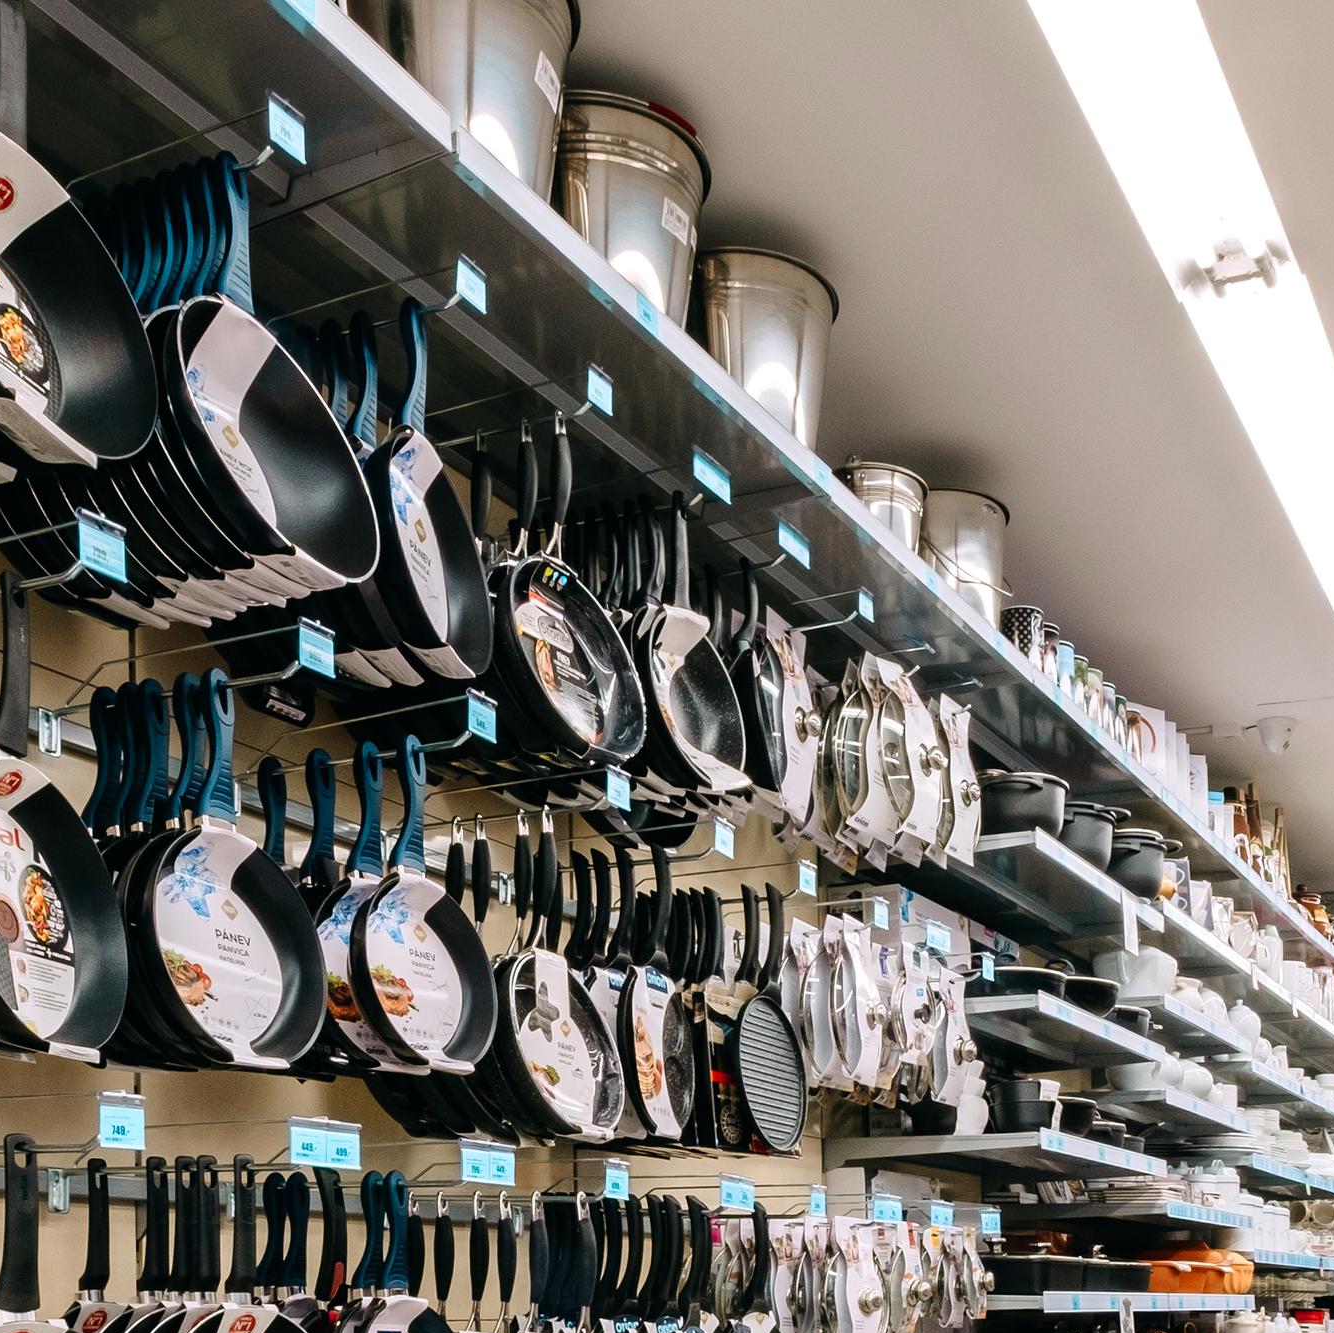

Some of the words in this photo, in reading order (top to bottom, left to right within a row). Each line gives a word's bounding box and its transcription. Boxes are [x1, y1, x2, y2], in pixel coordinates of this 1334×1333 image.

[215, 928, 251, 947] PÁNEV
[647, 973, 667, 989] orion
[111, 1125, 130, 1137] 749,-
